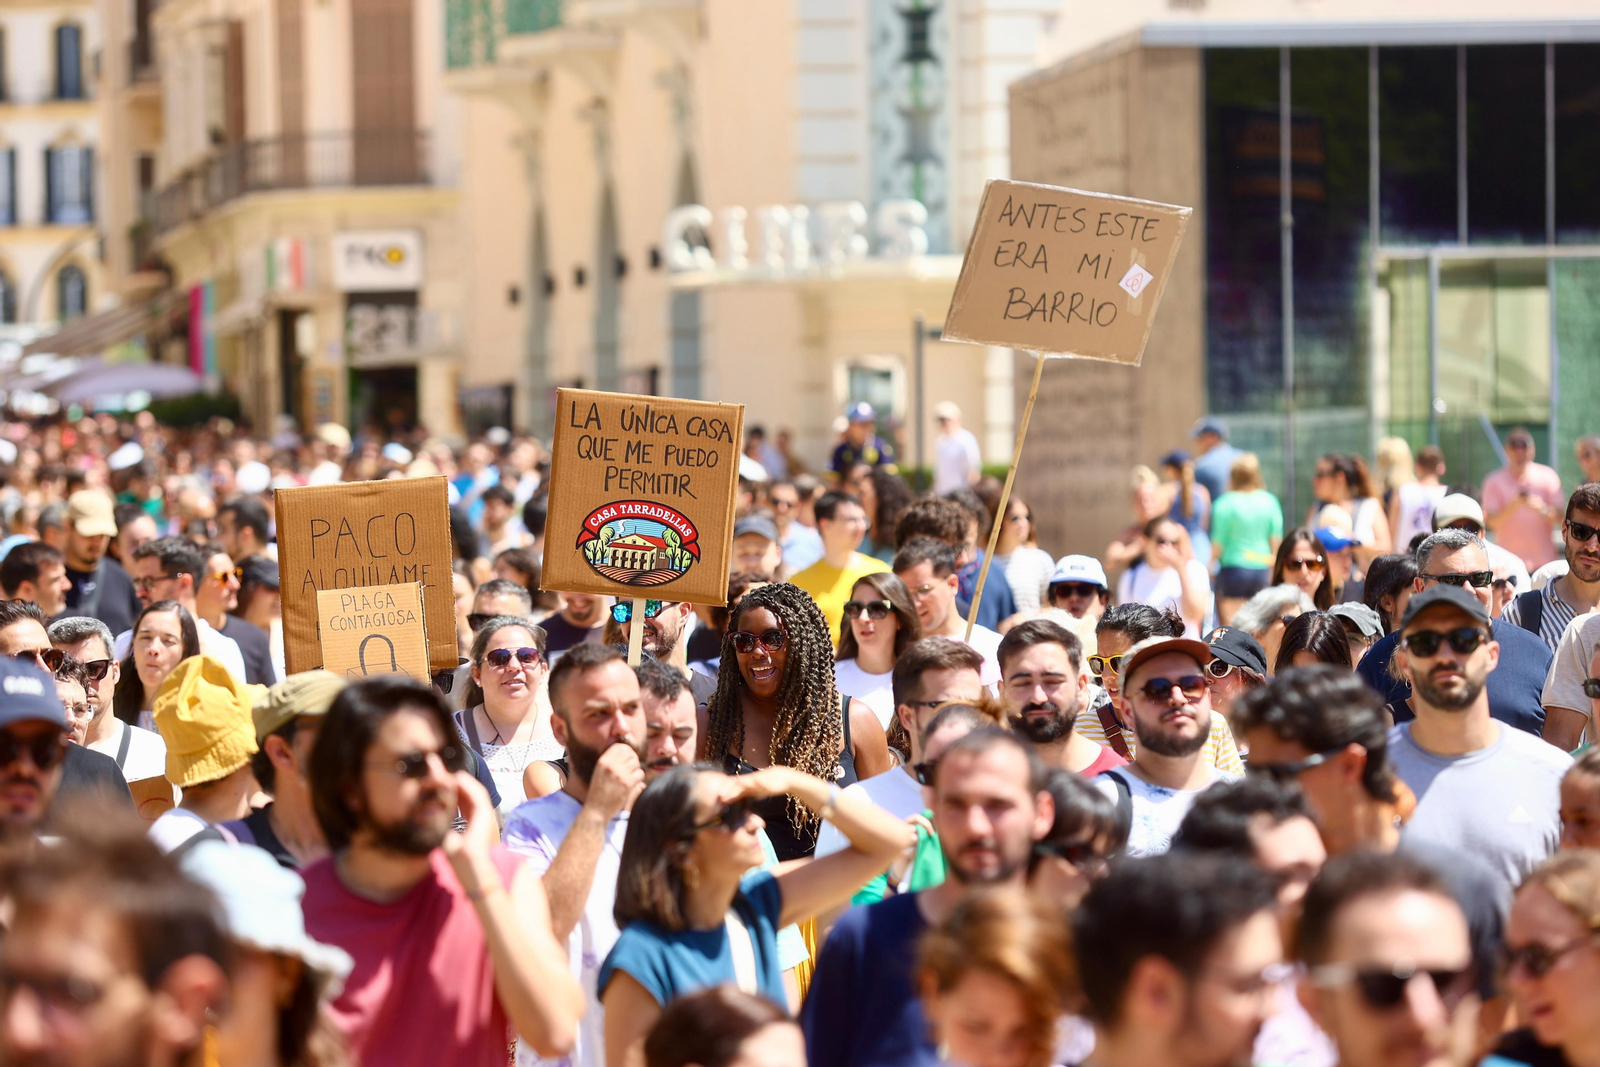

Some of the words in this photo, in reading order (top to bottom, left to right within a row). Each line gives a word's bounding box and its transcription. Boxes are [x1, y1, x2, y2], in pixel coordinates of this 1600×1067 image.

[998, 195, 1087, 234] ANTES
[1096, 212, 1160, 242] ESTE
[994, 239, 1048, 274] ERA
[1003, 287, 1118, 327] BARRIO
[570, 401, 602, 430] LA
[620, 404, 679, 435] ÚNICA
[686, 416, 734, 443] CASA
[577, 435, 619, 461] QUE
[624, 440, 654, 465] ME
[664, 444, 719, 468] PUEDO
[604, 465, 698, 500] PERMITIR
[590, 507, 618, 526] CASA
[619, 504, 693, 537] TARRADELLAS
[340, 591, 396, 613] PLAGA
[329, 609, 417, 632] CONTAGIOSA
